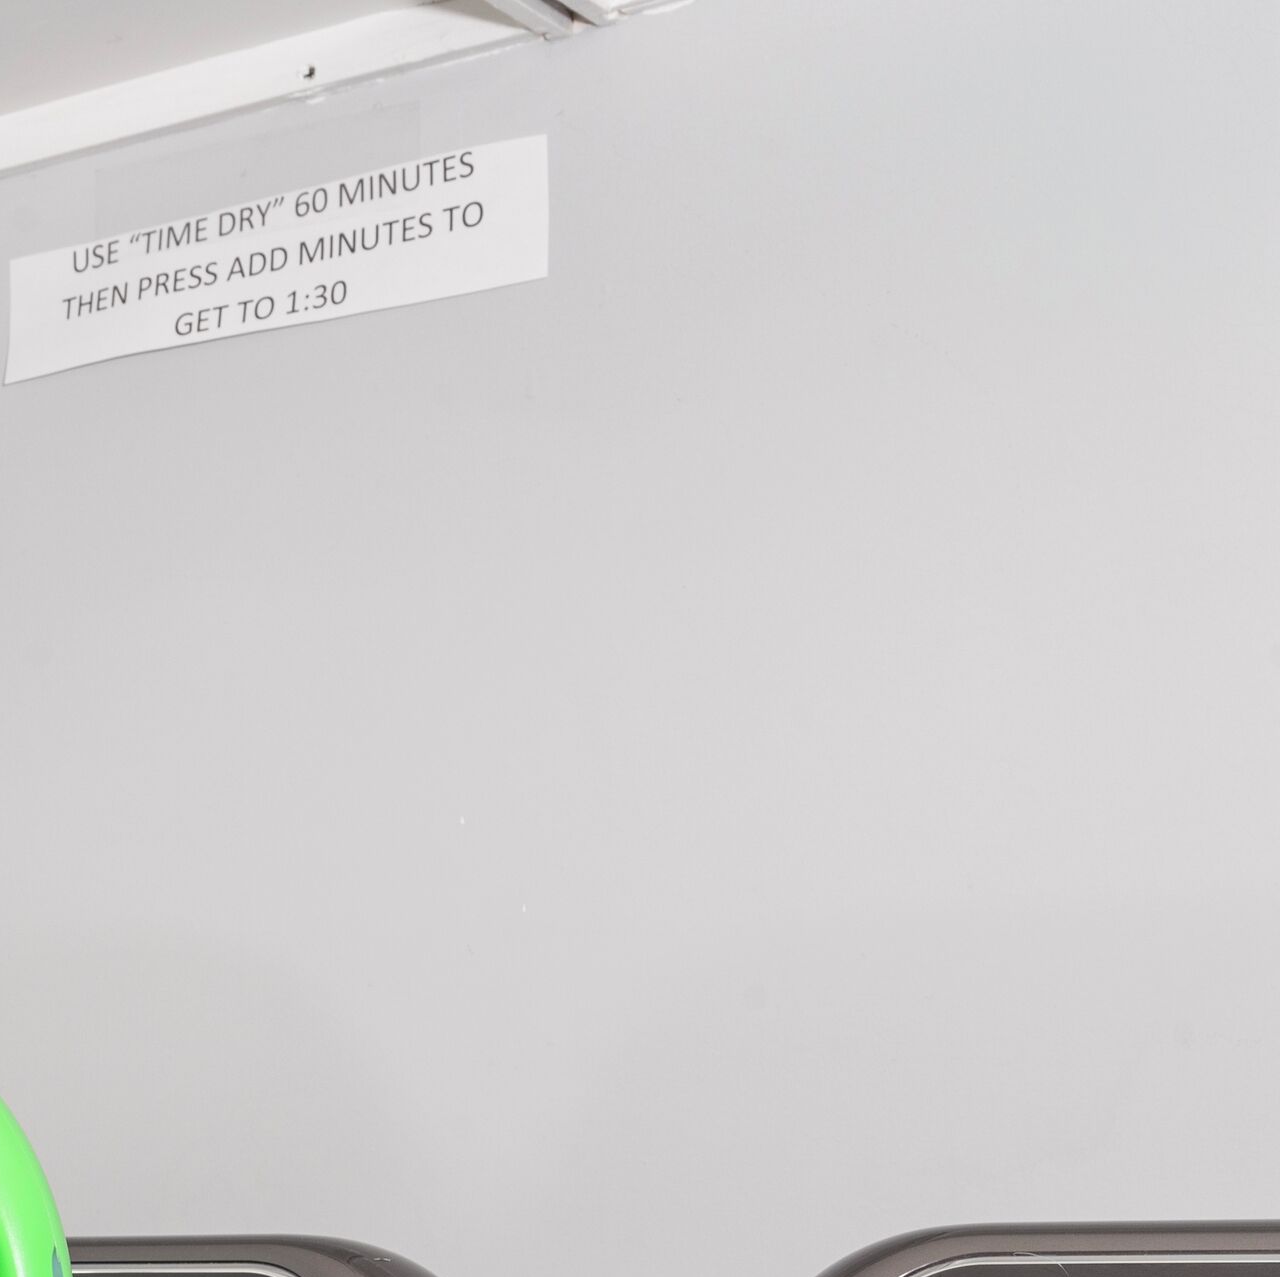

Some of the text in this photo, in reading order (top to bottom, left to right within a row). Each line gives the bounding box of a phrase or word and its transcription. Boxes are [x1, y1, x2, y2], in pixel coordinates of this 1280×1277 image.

[63, 201, 484, 320] THEN PRESS ADD MINUTES TO
[72, 240, 120, 273] USE
[295, 188, 328, 218] 60
[339, 151, 475, 208] MINUTES
[175, 280, 347, 336] GET TO 1:30
